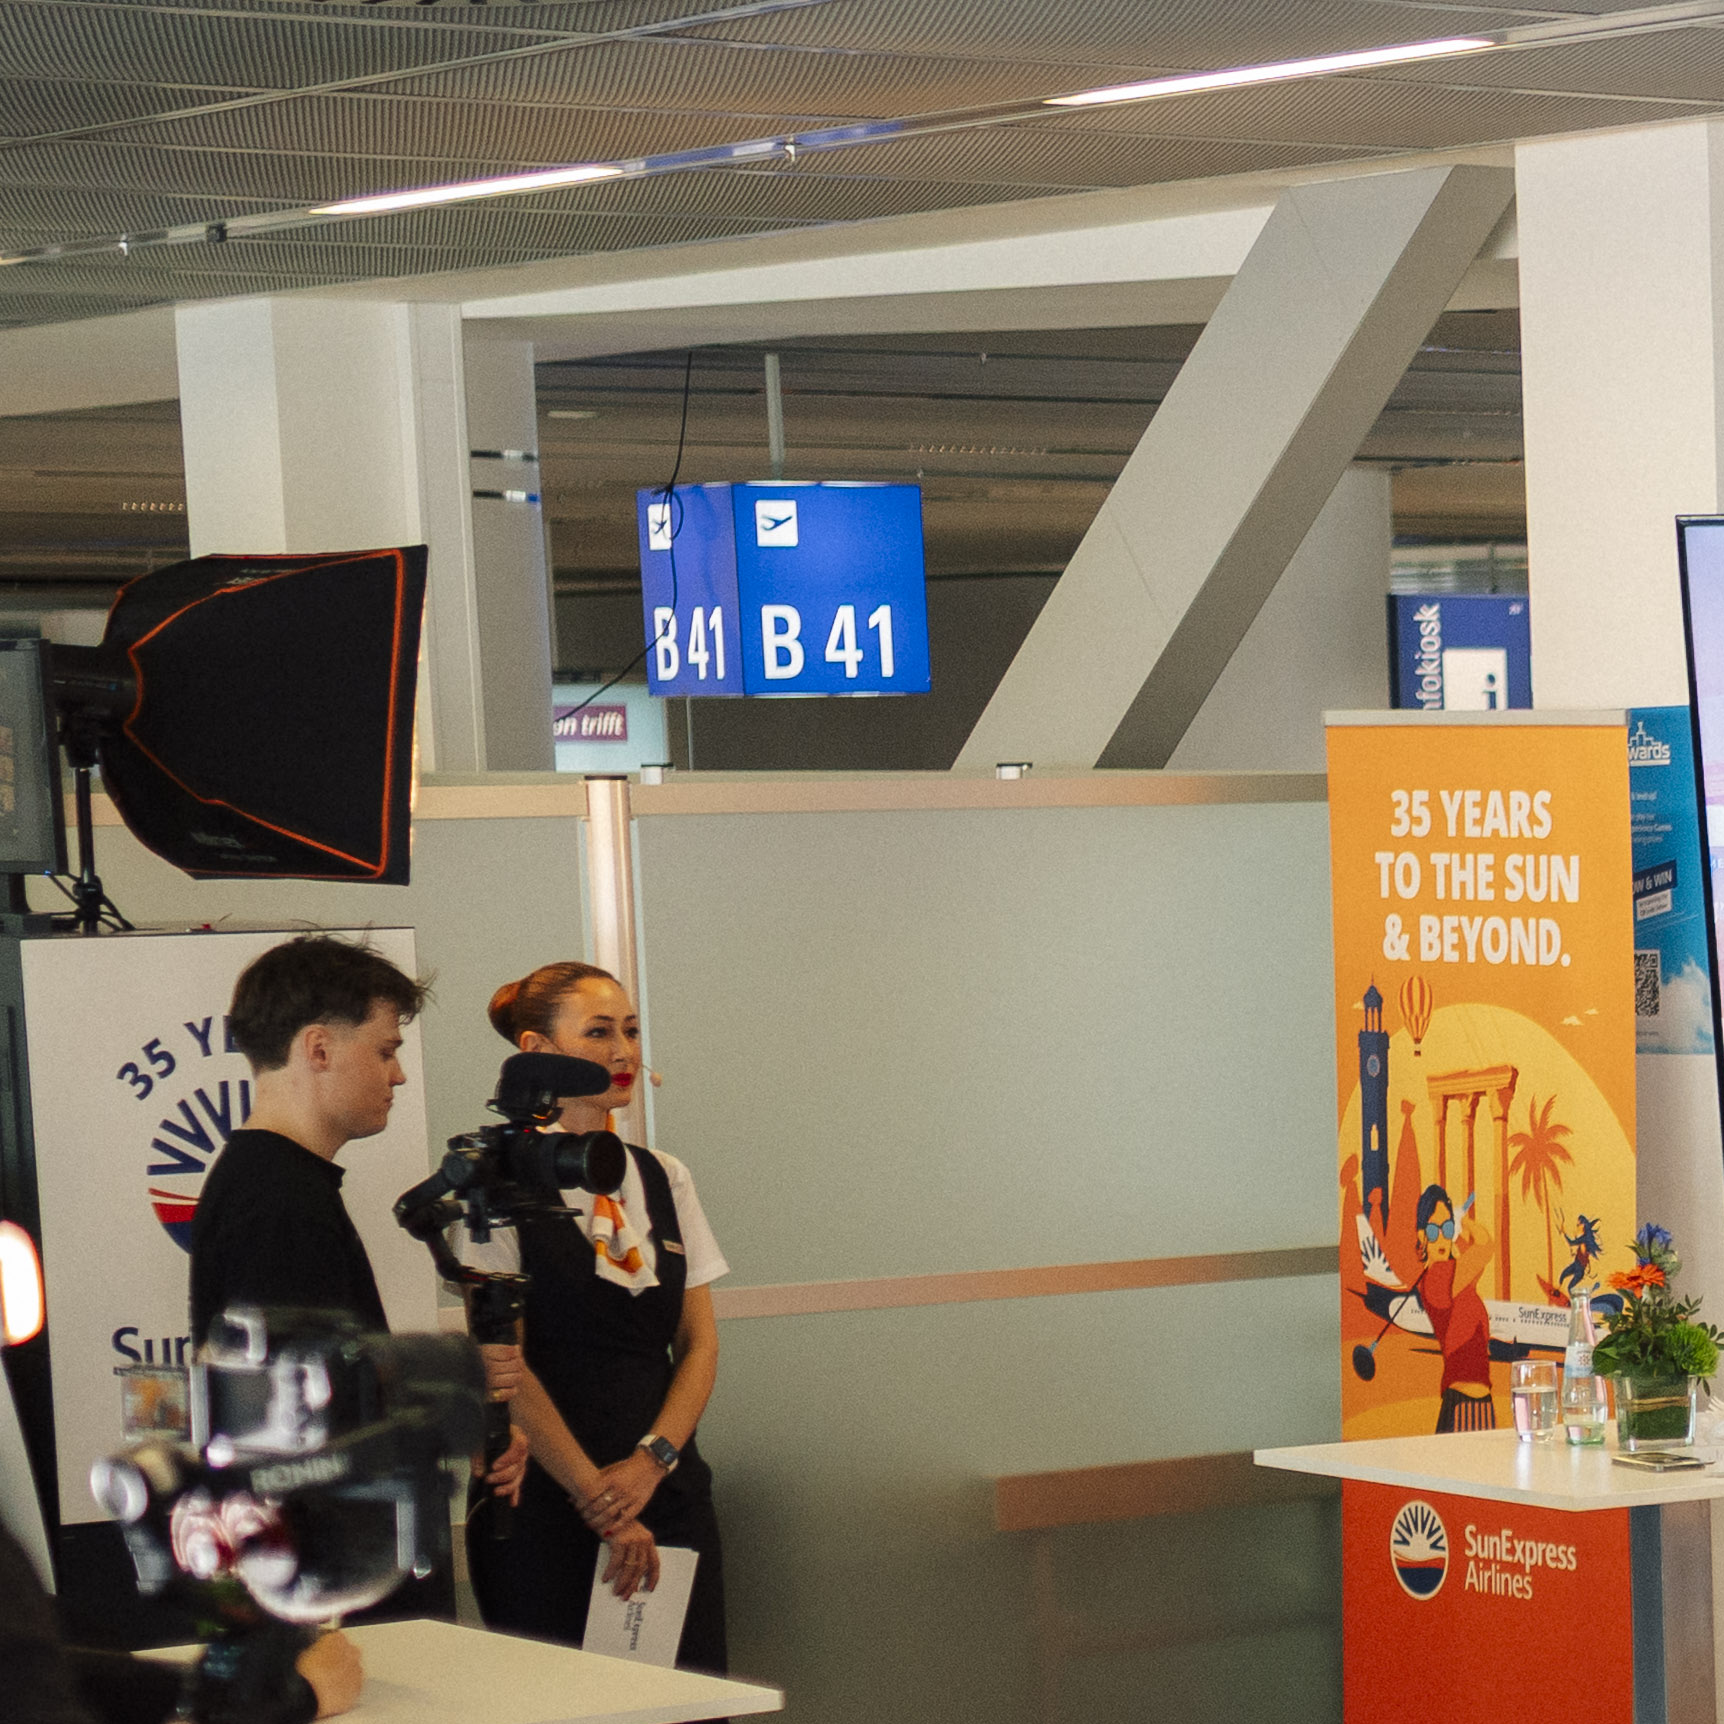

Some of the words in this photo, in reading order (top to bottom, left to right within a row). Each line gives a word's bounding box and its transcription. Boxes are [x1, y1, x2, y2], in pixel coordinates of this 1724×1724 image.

[654, 606, 680, 681] B
[687, 606, 725, 680] 41
[760, 604, 805, 680] B
[825, 604, 895, 678] 41
[581, 711, 624, 736] trifft
[1390, 789, 1431, 838] 35
[1439, 789, 1552, 839] YEARS
[1375, 851, 1421, 900] TO
[1430, 853, 1495, 901] THE
[1504, 854, 1580, 903] SUN
[1654, 869, 1672, 887] WIN
[1383, 913, 1411, 961] &
[1419, 914, 1571, 968] BEYOND.
[116, 1037, 176, 1101] 35
[1519, 1307, 1567, 1325] SunExpress
[1465, 1524, 1577, 1574] SunExpress
[1465, 1560, 1533, 1600] Airlines
